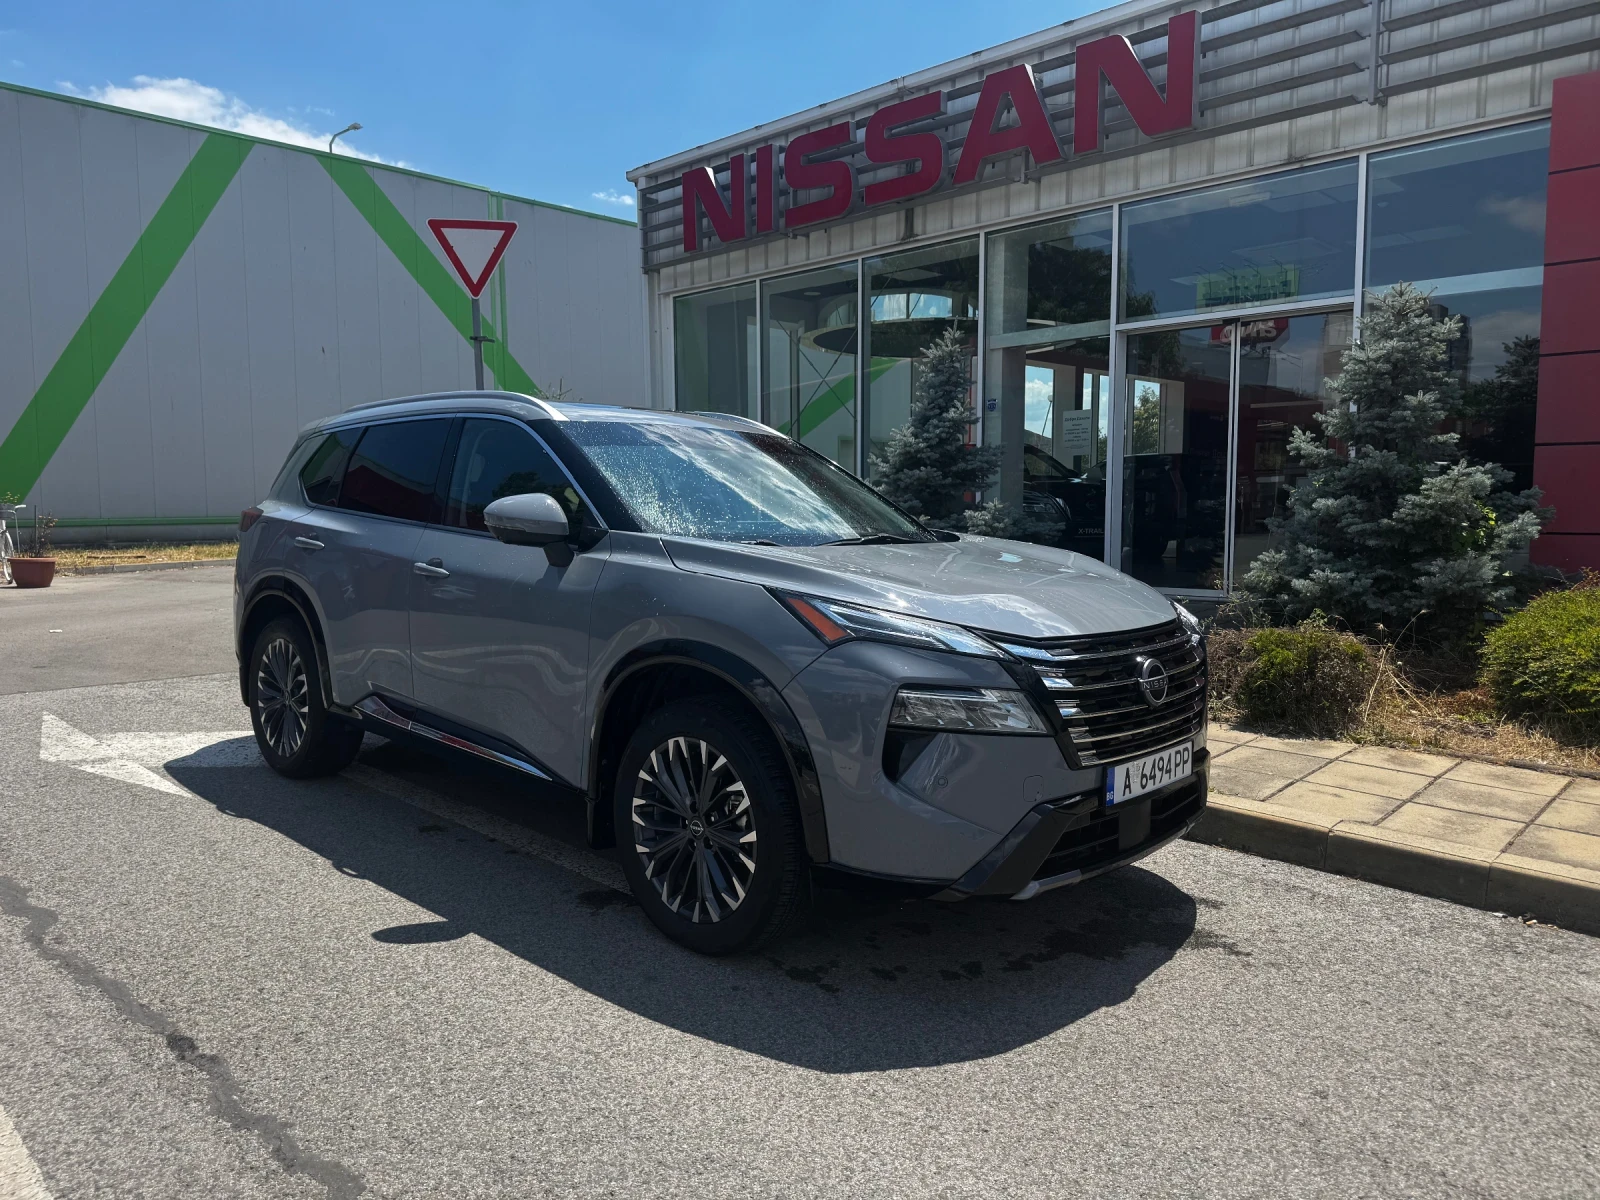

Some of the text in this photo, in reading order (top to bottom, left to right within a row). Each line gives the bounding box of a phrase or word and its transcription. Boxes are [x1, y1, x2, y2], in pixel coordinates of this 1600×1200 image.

[682, 10, 1199, 252] NISSAN
[1143, 679, 1168, 689] NISS
[1106, 791, 1114, 801] BG
